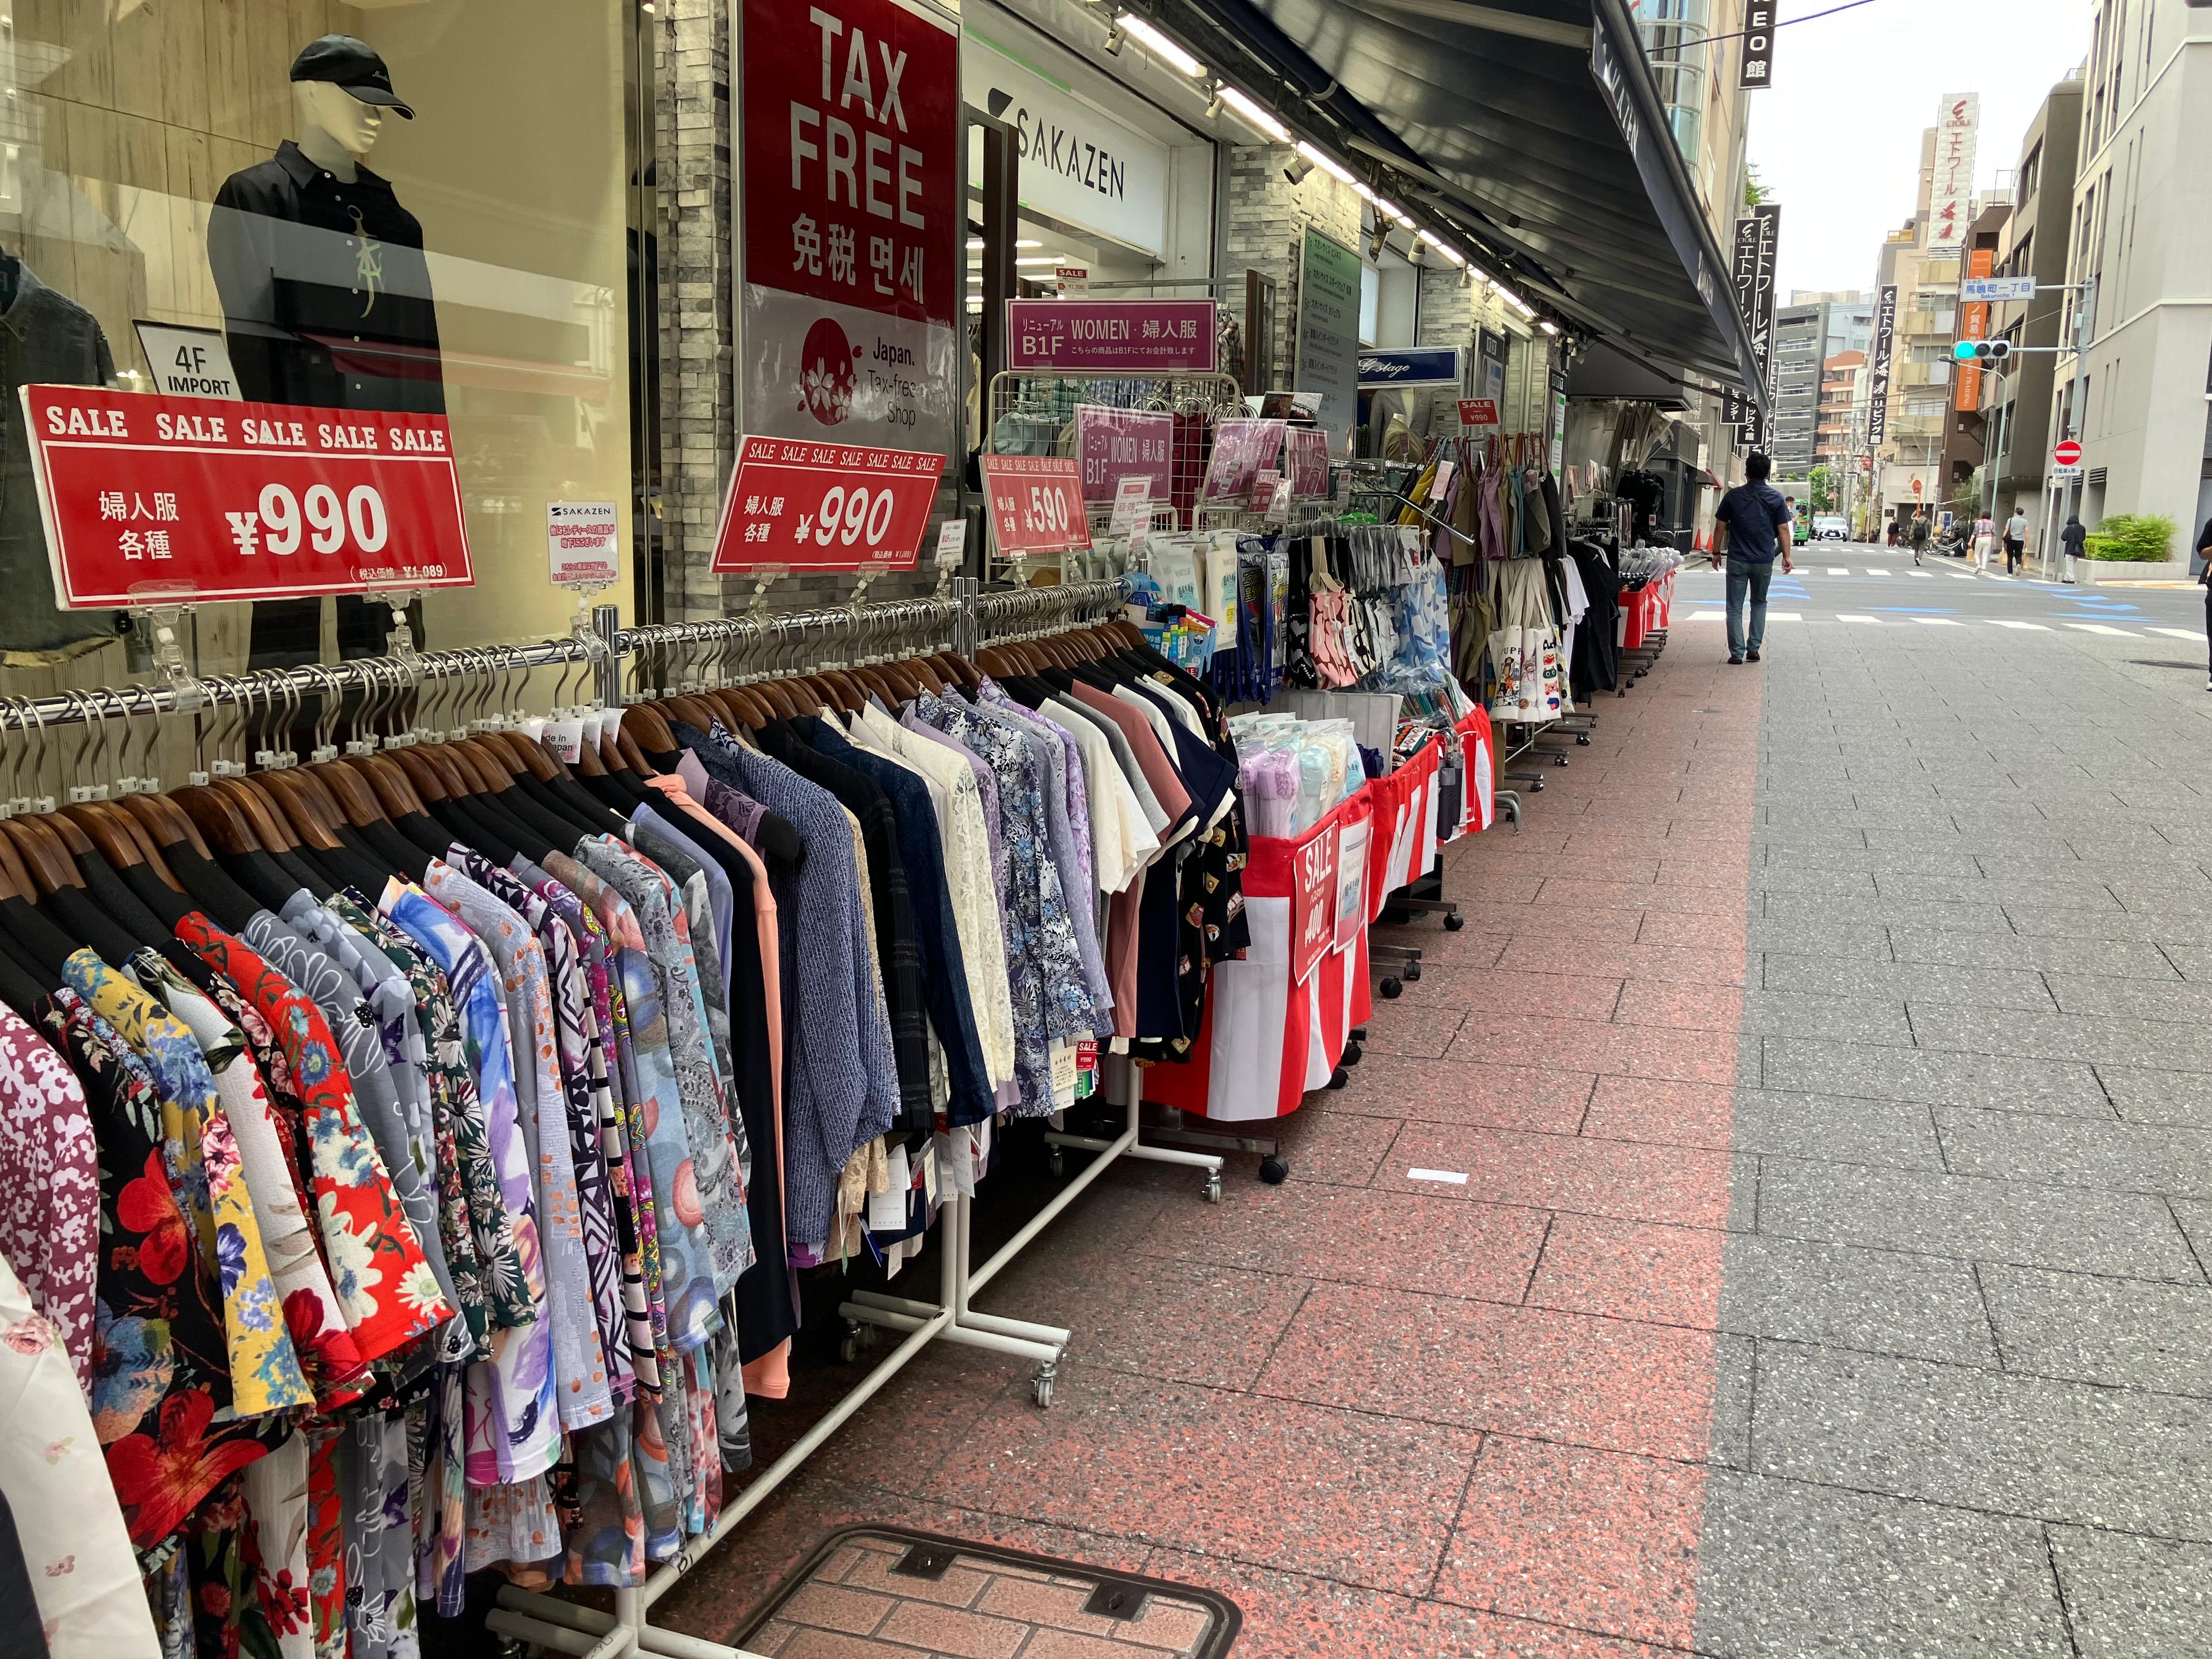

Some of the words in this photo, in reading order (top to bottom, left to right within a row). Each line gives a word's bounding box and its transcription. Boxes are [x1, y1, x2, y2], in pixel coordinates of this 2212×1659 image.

[1746, 0, 1767, 78] EO館
[809, 5, 908, 133] TAX
[790, 101, 925, 230] FREE
[1017, 107, 1124, 202] SAKAZEN
[792, 213, 856, 287] 免税
[870, 236, 924, 304] 면세
[1965, 283, 2030, 294] 馬喰町一丁目
[1022, 318, 1064, 332] リニューアル
[1071, 319, 1129, 341] WOMEN
[1142, 319, 1198, 340] 婦人服
[873, 336, 915, 367] Japan.
[1022, 336, 1065, 355] B1F
[175, 347, 206, 374] 4F
[167, 376, 230, 396] IMPORT
[867, 369, 916, 398] Tax-free
[47, 406, 128, 438] SALE
[156, 413, 228, 442] SALE
[241, 418, 307, 446] SALE
[319, 423, 378, 450] SALE
[389, 428, 446, 452] SALE
[887, 401, 916, 430] Shop
[749, 443, 776, 460] SALE
[781, 446, 807, 461] SALE
[811, 448, 835, 464] SALE
[840, 451, 863, 466] SALE
[867, 453, 890, 468] SALE
[891, 456, 912, 470] SALE
[916, 457, 938, 472] SALE
[1111, 436, 1137, 464] WOMEN
[1142, 438, 1165, 463] 婦人服
[987, 458, 999, 470] SALE
[1001, 459, 1013, 471] SALE
[1014, 460, 1027, 471] SALE
[1028, 460, 1039, 471] SALE
[1041, 461, 1052, 472] SALE
[1052, 461, 1063, 472] SALE
[1065, 461, 1075, 472] SALE
[1086, 458, 1108, 484] B1F
[1259, 474, 1277, 484] SALE
[99, 490, 179, 521] 婦人服
[225, 483, 388, 556] ¥990
[744, 495, 785, 516] 婦人服
[794, 486, 893, 546] ¥990
[1024, 487, 1068, 533] ¥590
[118, 529, 173, 560] 各種
[550, 524, 615, 536] 他にもレディースの商品が
[560, 537, 605, 548] 地下にございます
[744, 523, 771, 543] 各種
[546, 734, 556, 742] de
[559, 734, 566, 742] In
[1305, 828, 1332, 893] SALE
[1079, 1043, 1098, 1051] SALE
